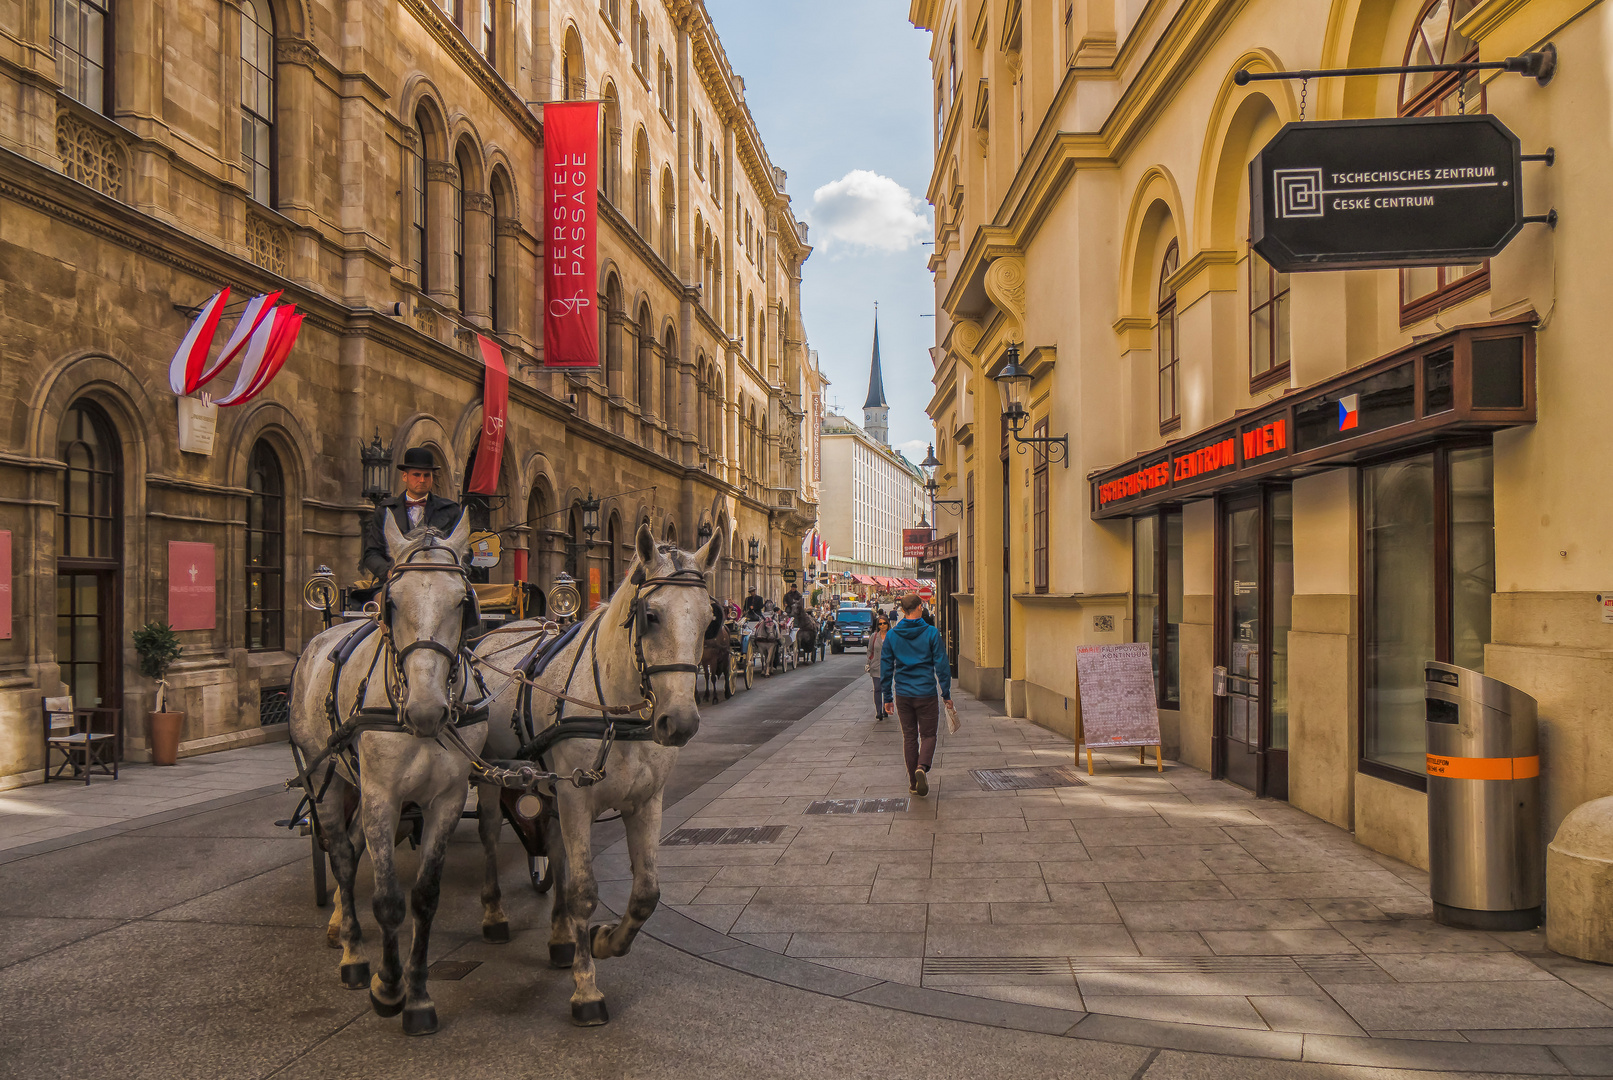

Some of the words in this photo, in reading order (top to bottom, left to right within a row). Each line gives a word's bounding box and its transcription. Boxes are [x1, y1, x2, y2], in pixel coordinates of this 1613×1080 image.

[1331, 169, 1431, 184] TSCHECHISCHES
[1434, 166, 1495, 179] ZENTRUM
[553, 154, 568, 276] FERSTEL
[571, 152, 587, 276] PASSAGE
[1333, 196, 1371, 210] ČESKÉ
[1374, 195, 1434, 208] CENTRUM
[1098, 461, 1169, 505] TSCHECHISCHES
[1174, 438, 1235, 481] ZENTRUM
[1242, 419, 1286, 460] WIEN
[1078, 646, 1100, 654] MARIE
